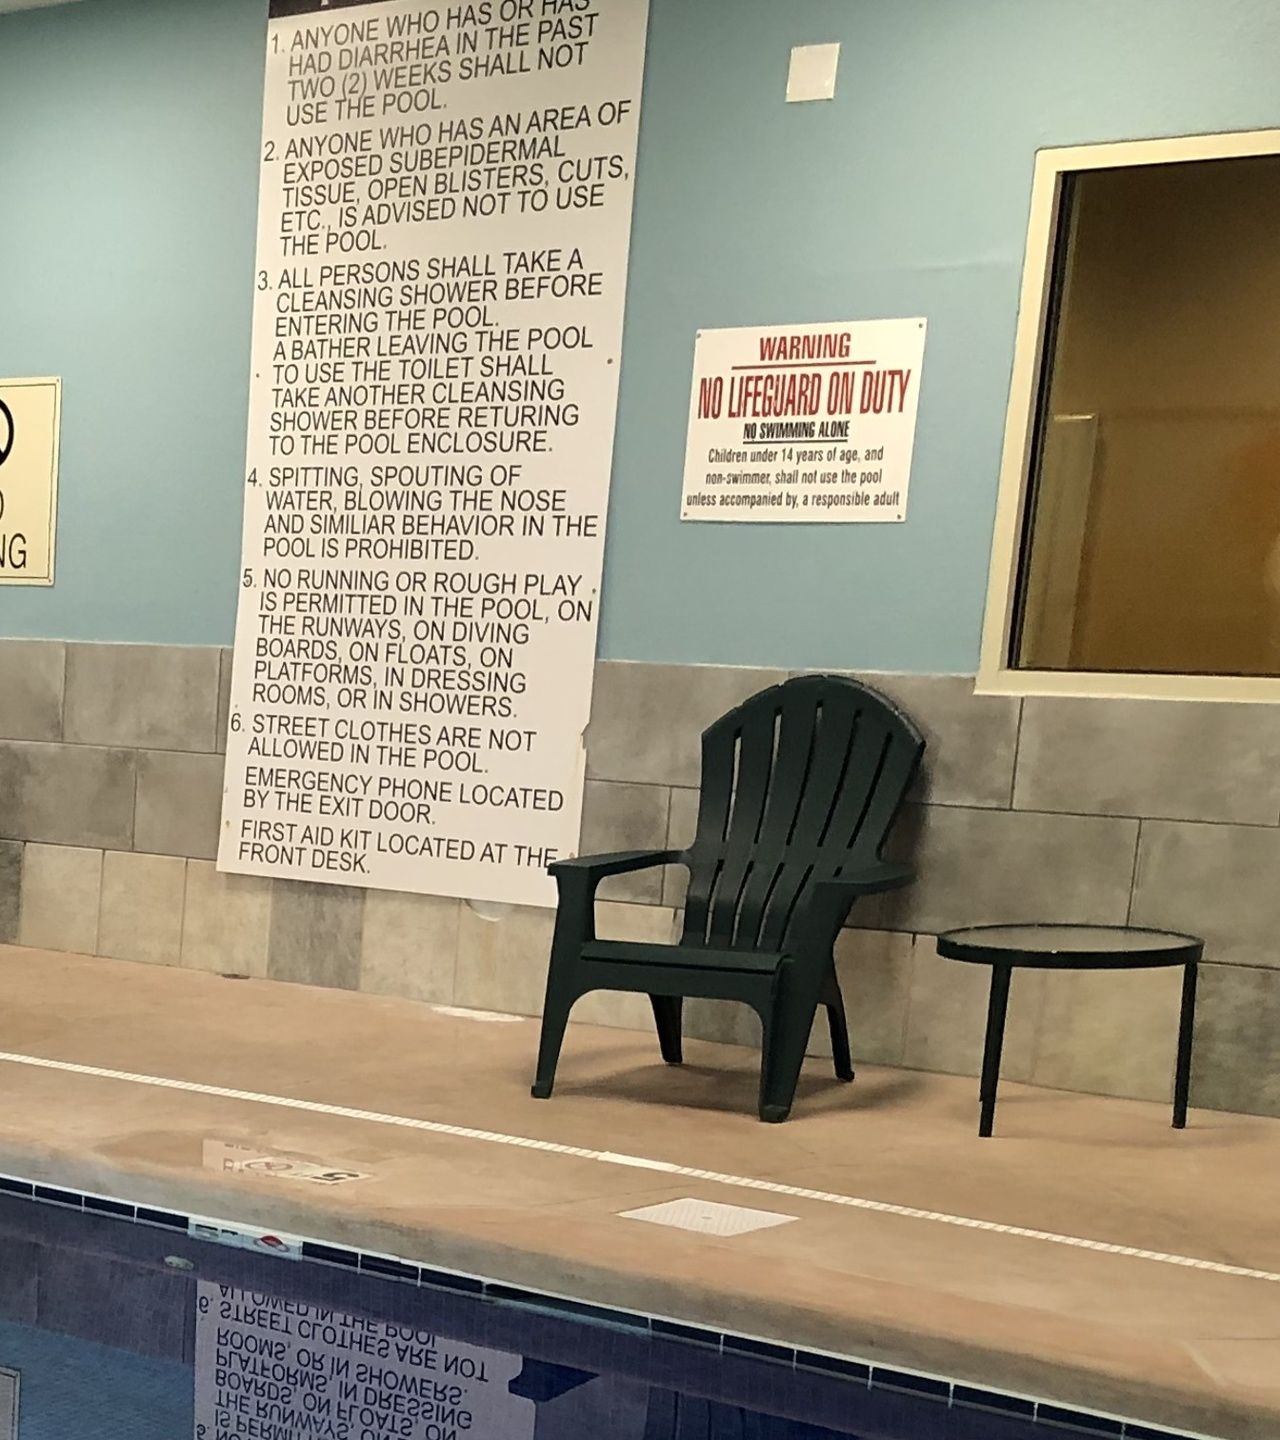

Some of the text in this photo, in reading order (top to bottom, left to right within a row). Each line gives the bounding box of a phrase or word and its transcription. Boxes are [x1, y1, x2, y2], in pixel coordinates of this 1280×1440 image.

[271, 33, 284, 53] 1.
[290, 18, 378, 51] ANYONE
[386, 10, 439, 37] WHO
[446, 2, 491, 29] HAS
[499, 0, 533, 21] OR
[289, 12, 598, 76] HAD DIARRHEA IN THE PAST
[287, 41, 588, 101] TWO (2) WEEKS SHALL NOT
[286, 87, 446, 126] USE THE POOL.
[263, 99, 631, 161] 2. ANYONE WHO HAS AN AREA OF
[283, 134, 565, 183] EXPOSED SUBEPIDERMAL
[282, 154, 628, 208] TISSUE, OPEN BLISTERS, CUTS,
[339, 205, 356, 228] IS
[361, 197, 455, 226] ADVISED
[462, 191, 511, 217] NOT
[516, 188, 548, 212] TO
[556, 183, 604, 209] USE
[279, 229, 386, 256] THE POOL.
[758, 332, 851, 361] WARNING
[697, 369, 910, 419] NO LIFEGUARD ON DUTY
[743, 420, 850, 439] NO SWIMMING ALONE
[708, 448, 747, 463] Children
[750, 447, 777, 462] under
[781, 448, 793, 460] 14
[794, 450, 823, 464] years
[826, 447, 836, 461] of
[864, 446, 883, 460] and
[247, 464, 521, 488] 4. SPITTING, SPOUTING OF
[705, 469, 882, 486] non-swimmer, shall not use the pool
[265, 488, 566, 513] WATER, BLOWING THE NOSE
[686, 492, 716, 505] unless
[719, 492, 782, 508] accompanied
[802, 495, 808, 506] a
[811, 492, 870, 508] responsible
[873, 491, 900, 505] adult
[263, 513, 598, 537] AND SIMILIAR BEHAVIOR IN THE
[230, 712, 536, 751] 6. STREET CLOTHES ARE NOT
[247, 736, 487, 772] ALLOWED IN THE POOL.
[243, 788, 434, 824] BY THE EXIT DOOR.
[245, 765, 563, 811] EMERGENCY PHONE LOCATED
[238, 841, 369, 873] FRONT DESK.
[241, 819, 558, 868] FIRST AID KIT LOCATED AT THE
